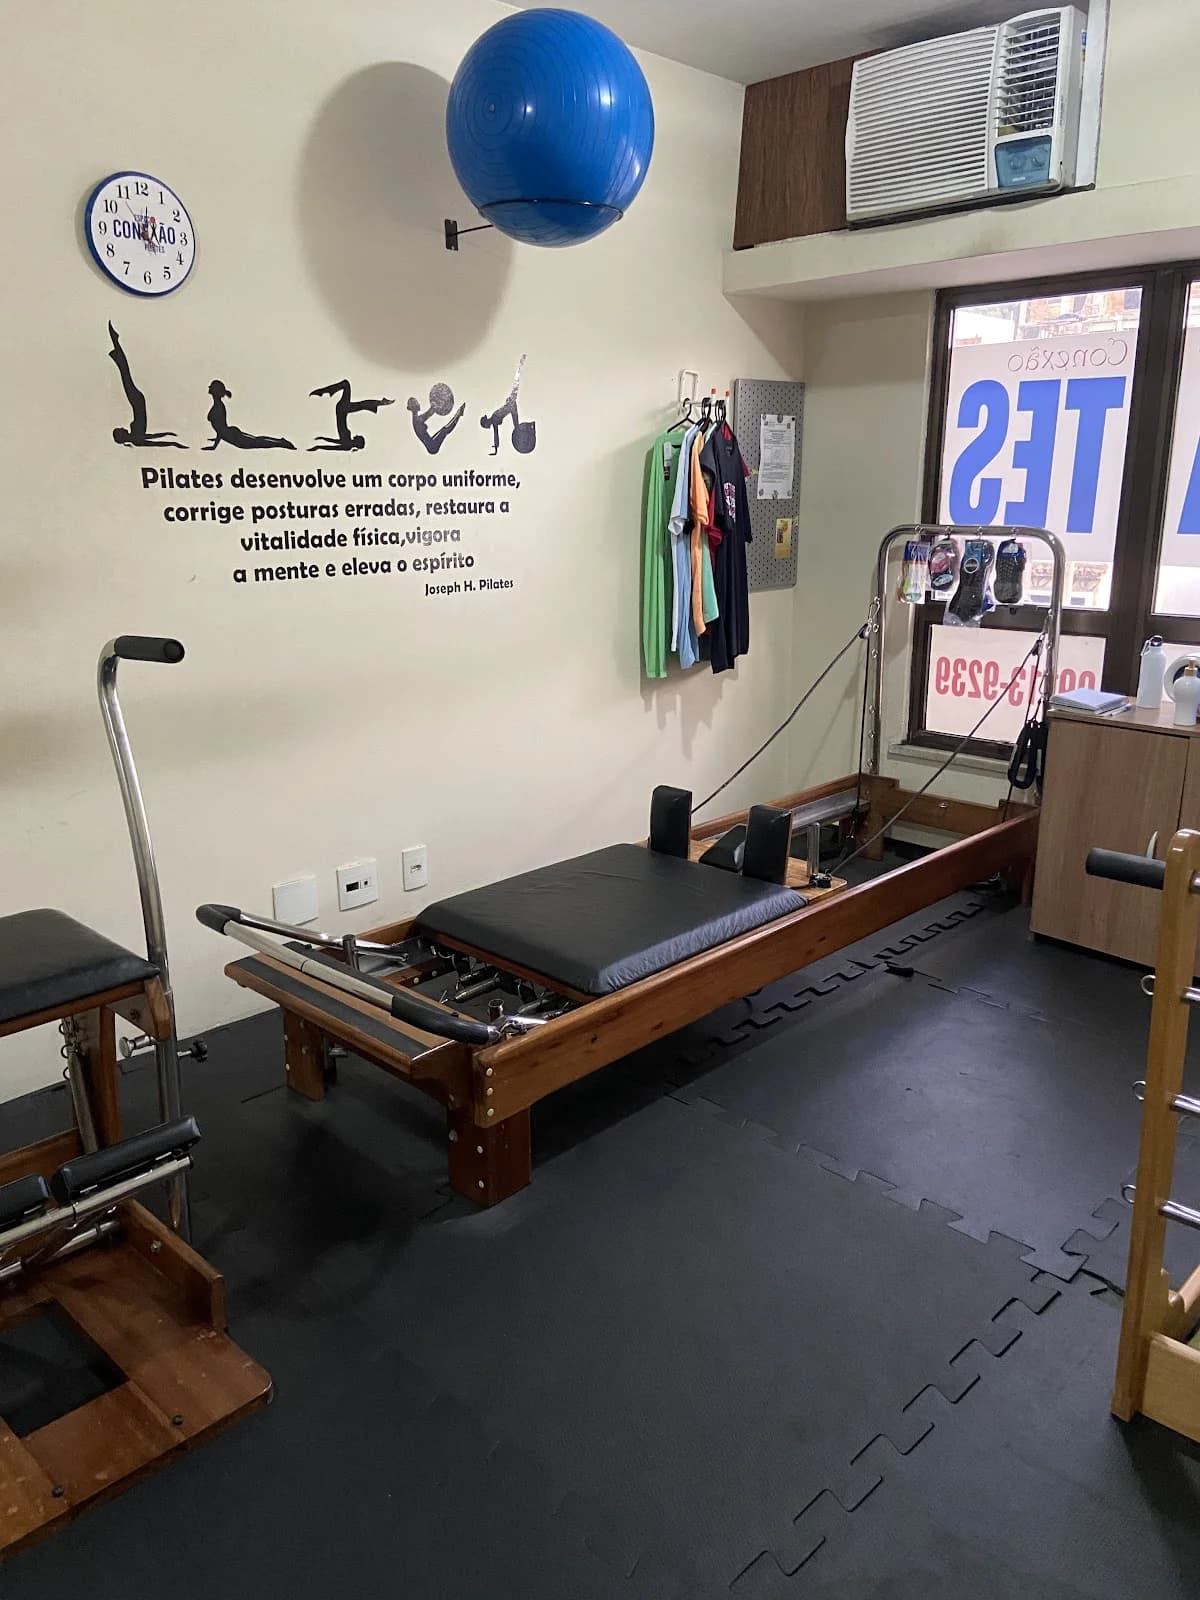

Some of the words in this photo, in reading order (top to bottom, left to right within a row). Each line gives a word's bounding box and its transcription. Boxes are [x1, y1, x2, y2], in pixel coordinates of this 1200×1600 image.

[117, 184, 131, 200] 11
[135, 181, 149, 196] 12
[159, 191, 164, 205] 1
[104, 199, 118, 214] 10
[172, 208, 181, 223] 2
[98, 220, 107, 235] 9
[180, 232, 188, 246] 3
[106, 243, 115, 257] 8
[176, 250, 184, 265] 4
[123, 260, 130, 275] 7
[163, 266, 171, 280] 5
[143, 270, 152, 285] 6
[140, 466, 224, 489] Pilates
[230, 467, 347, 489] desenvolve
[351, 473, 383, 489] um
[387, 473, 438, 492] corpo
[442, 469, 521, 490] uniforme,
[163, 500, 245, 525] corrige
[250, 500, 339, 525] posturas
[344, 497, 421, 519] erradas,
[425, 498, 495, 516] restaura
[499, 500, 510, 514] a
[240, 527, 348, 552] vitalidade
[232, 568, 248, 584] a
[253, 561, 320, 583] mente
[324, 562, 337, 578] e
[341, 556, 392, 577] eleva
[396, 559, 408, 573] o
[412, 551, 475, 575] espírito
[424, 580, 461, 598] Joseph
[463, 579, 477, 593] H.
[478, 577, 514, 591] Pilates
